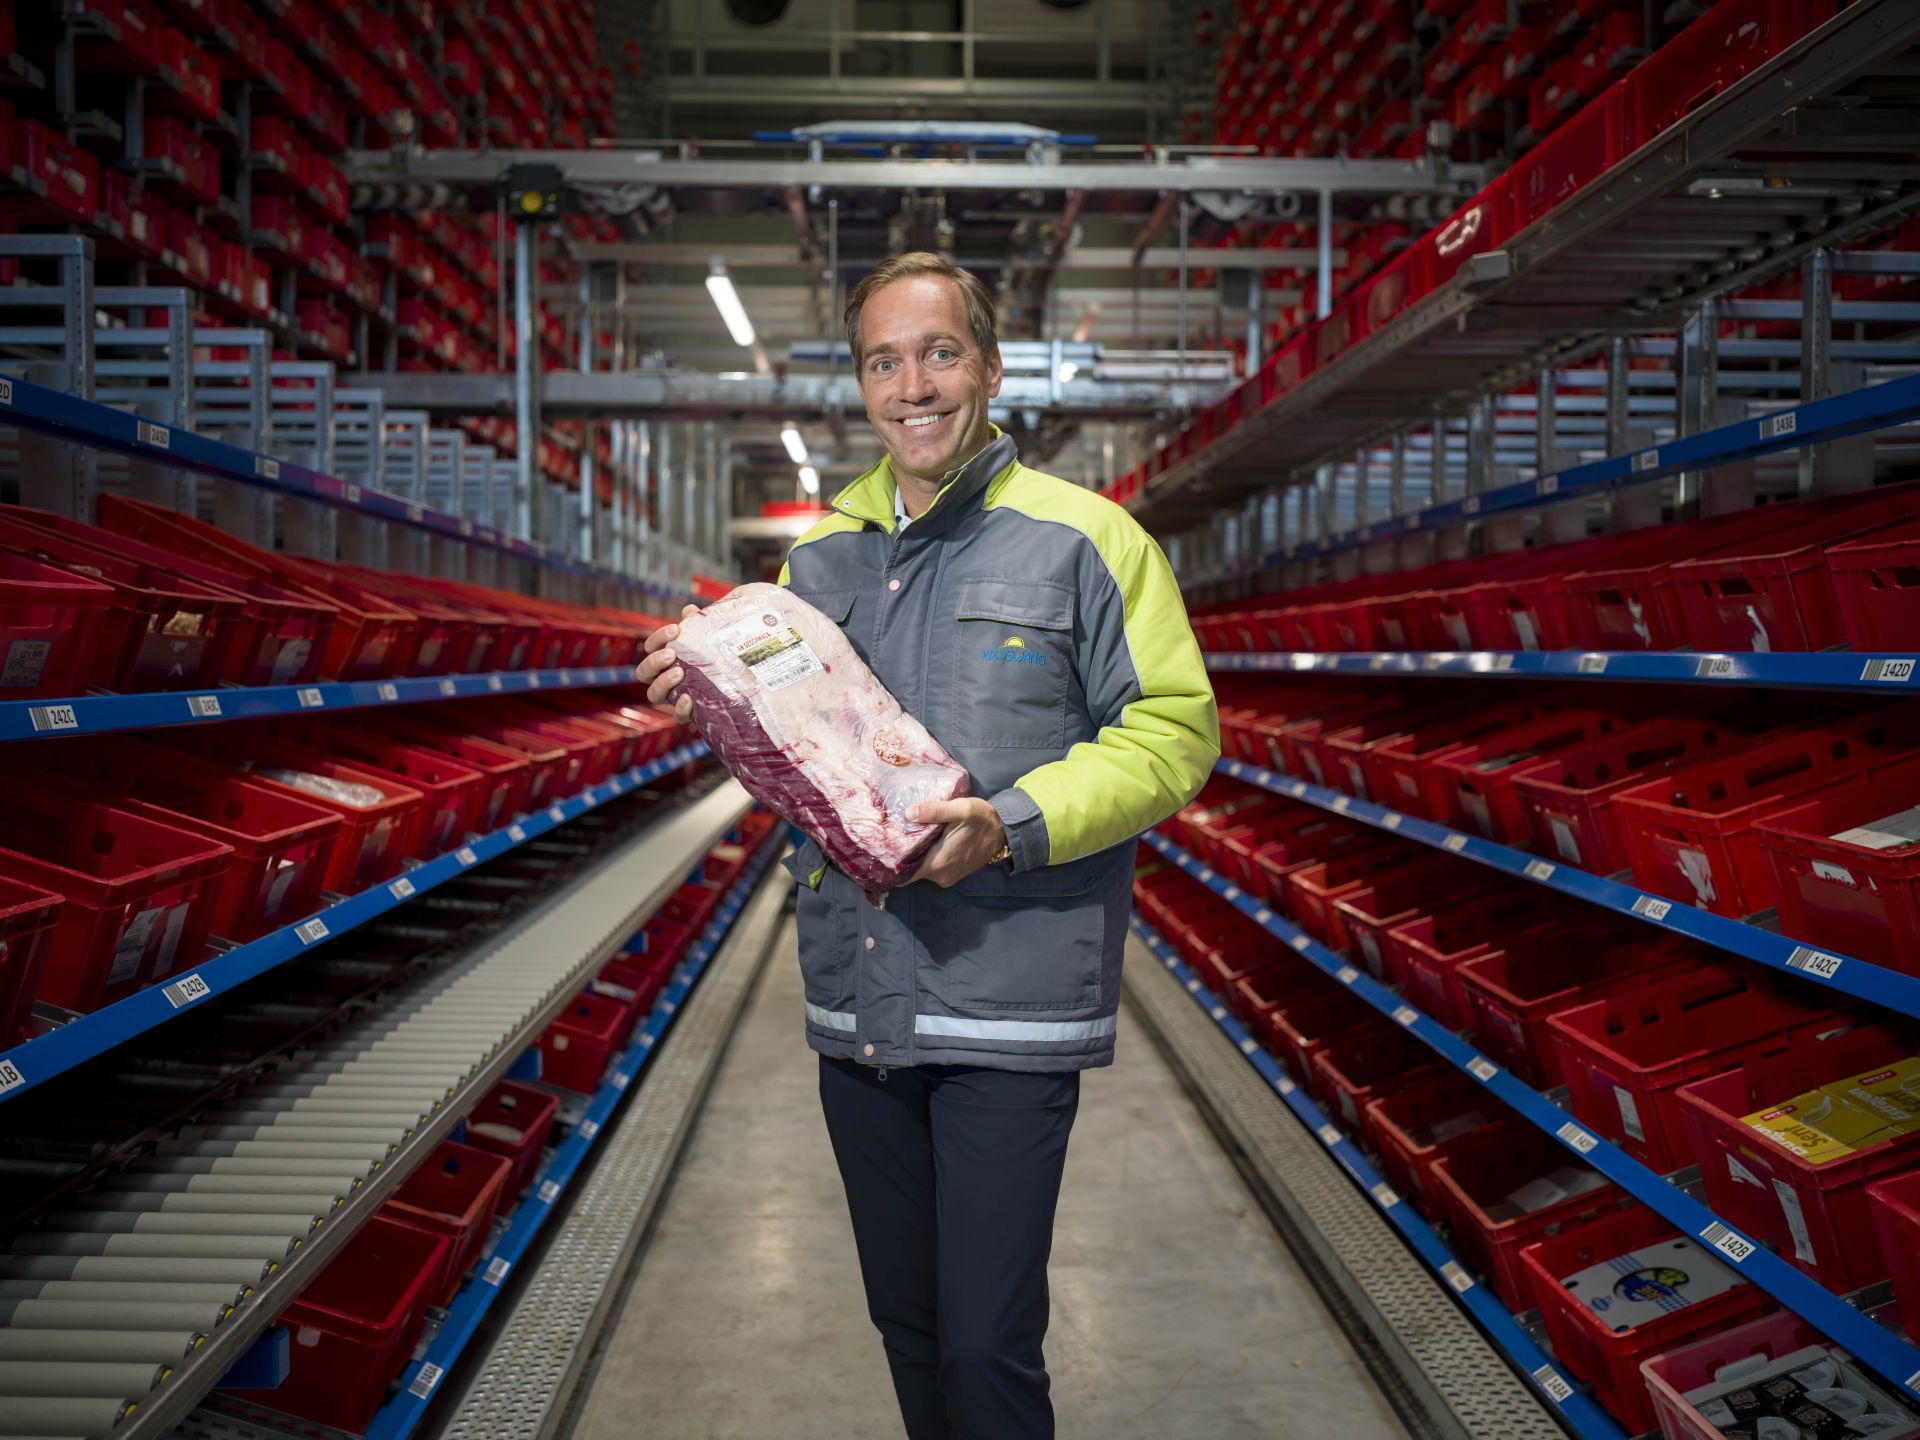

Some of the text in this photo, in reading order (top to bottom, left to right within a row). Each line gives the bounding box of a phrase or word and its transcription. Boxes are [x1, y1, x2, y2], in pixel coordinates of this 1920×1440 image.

[1775, 415, 1794, 432] 143E
[151, 428, 167, 445] 243D
[1711, 660, 1730, 673] 143D
[1882, 662, 1911, 678] 142D
[50, 709, 75, 725] 242C
[1808, 955, 1838, 974] 142C
[181, 977, 206, 997] 242B
[1776, 1124, 1829, 1148] Senf
[1721, 1236, 1750, 1258] 142B
[1547, 1378, 1569, 1399] 143A
